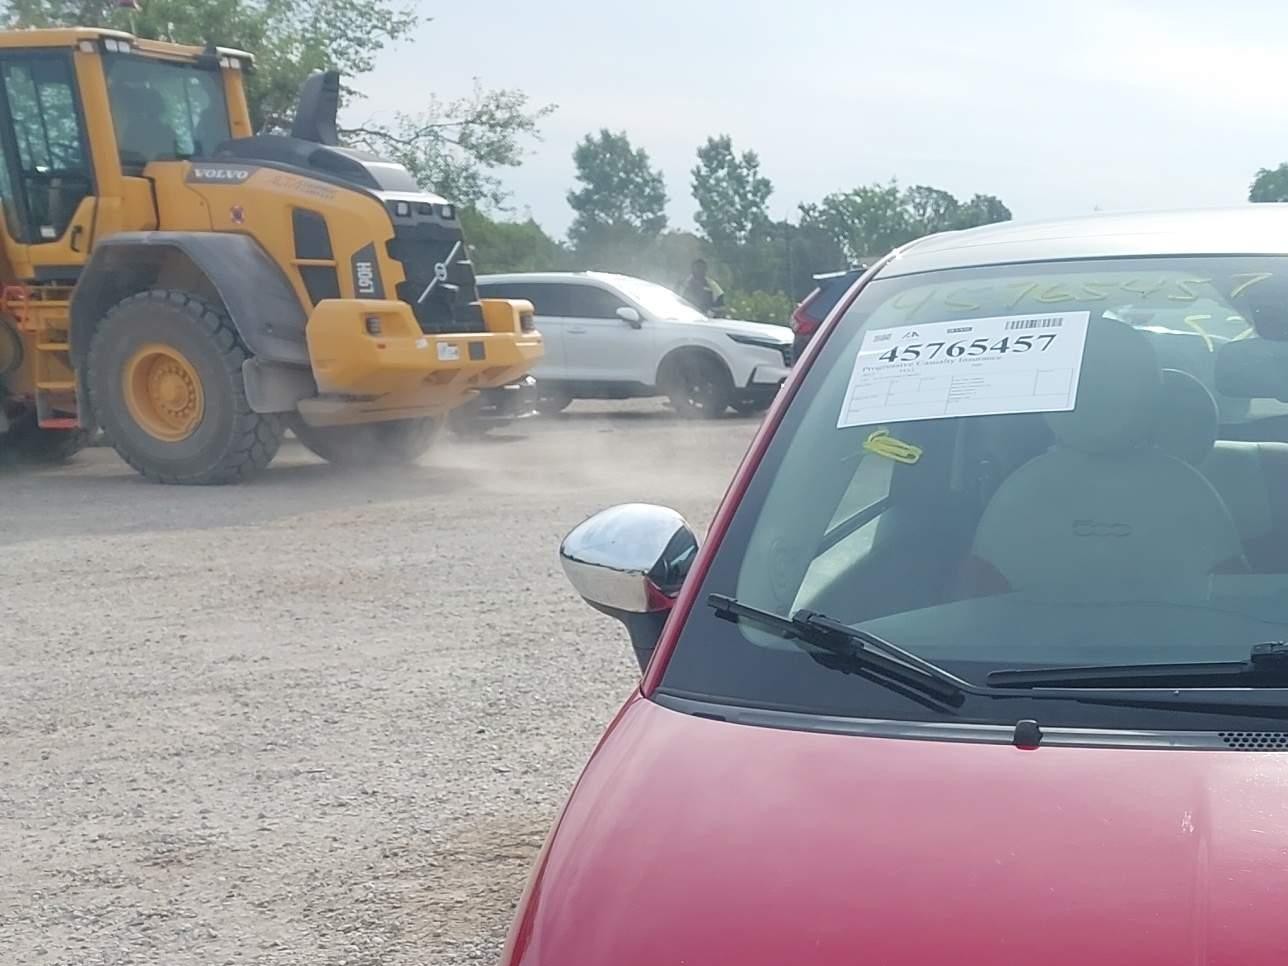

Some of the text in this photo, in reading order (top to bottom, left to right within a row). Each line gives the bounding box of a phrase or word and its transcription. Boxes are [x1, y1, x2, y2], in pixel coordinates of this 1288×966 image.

[193, 168, 249, 179] VOLVO
[356, 262, 375, 293] L90H
[878, 334, 1058, 363] 45765457
